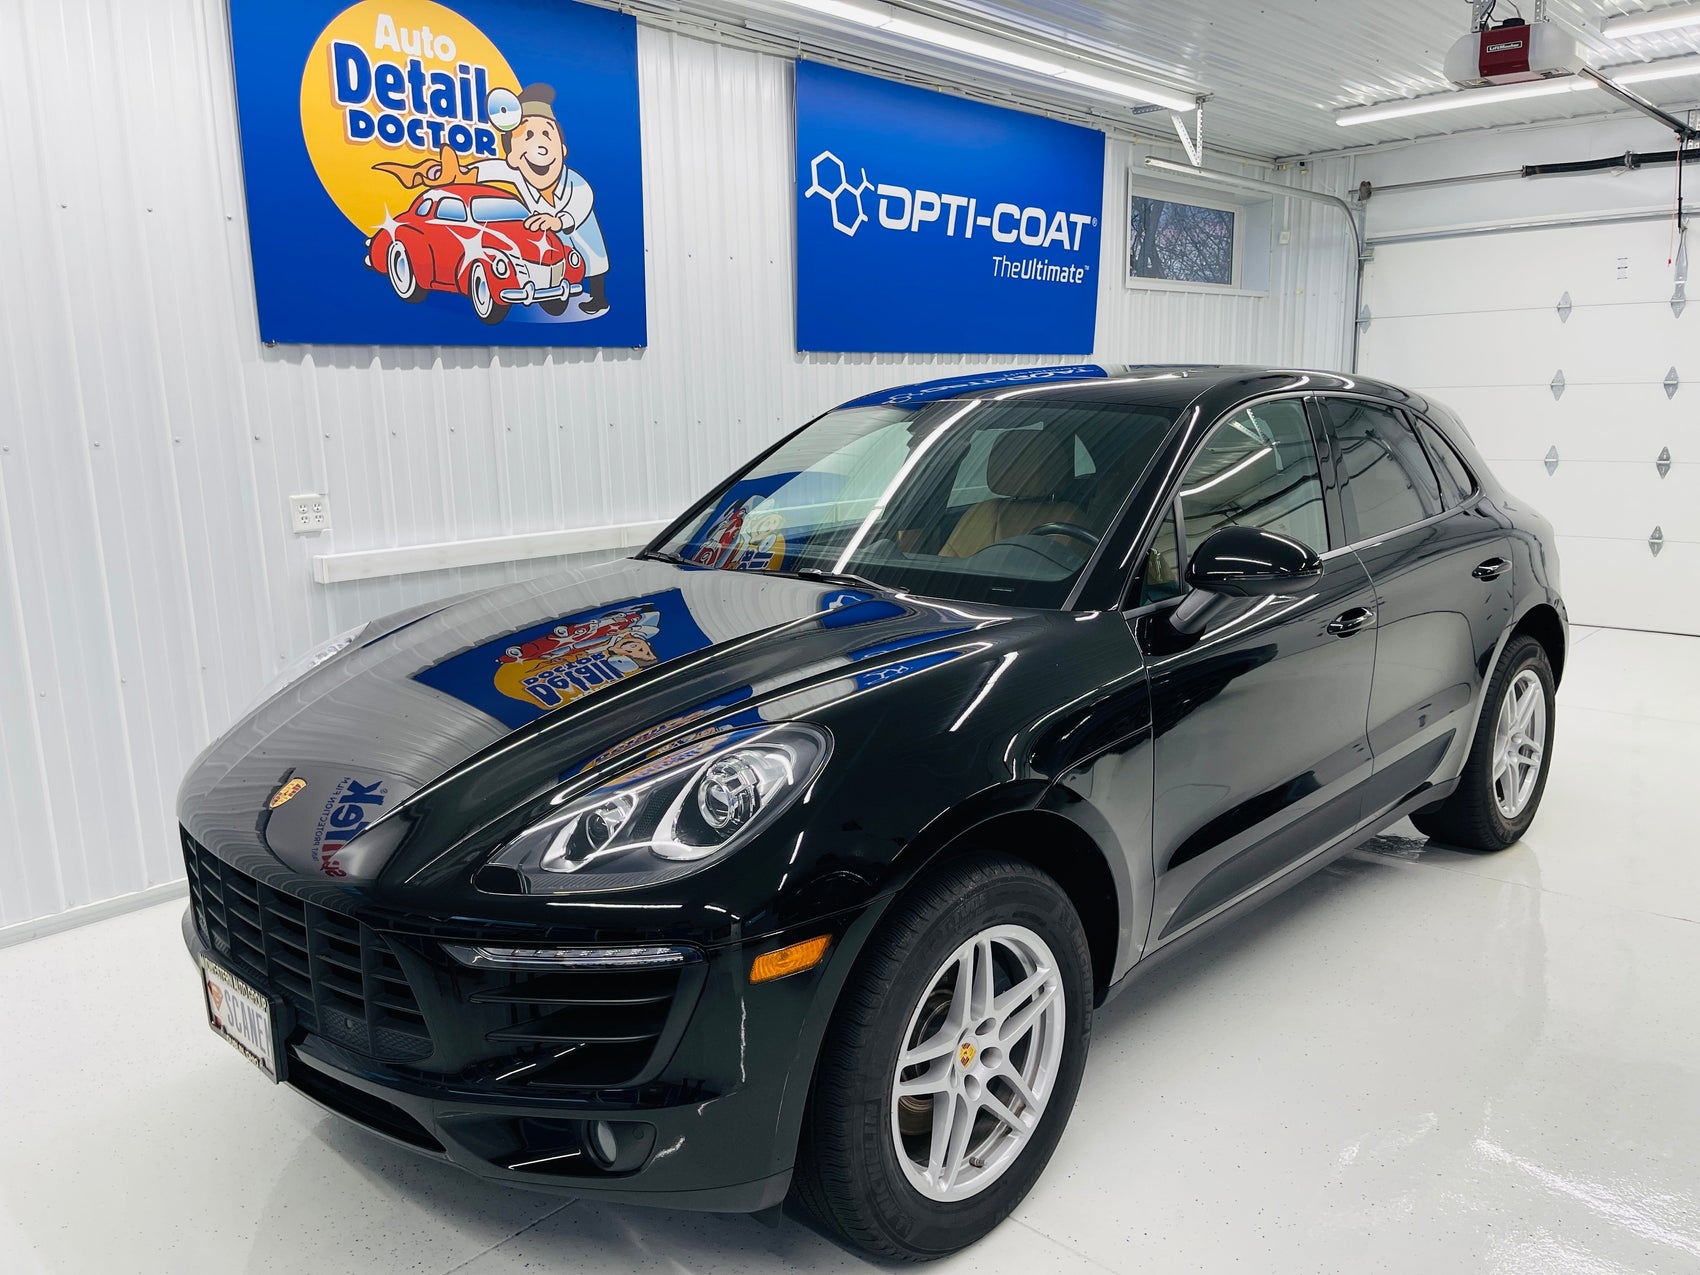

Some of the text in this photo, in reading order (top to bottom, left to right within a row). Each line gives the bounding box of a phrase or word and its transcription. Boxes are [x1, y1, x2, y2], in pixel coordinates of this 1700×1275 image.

[374, 14, 457, 62] Auto
[331, 41, 490, 126] Detail
[349, 108, 498, 158] DOCTOR
